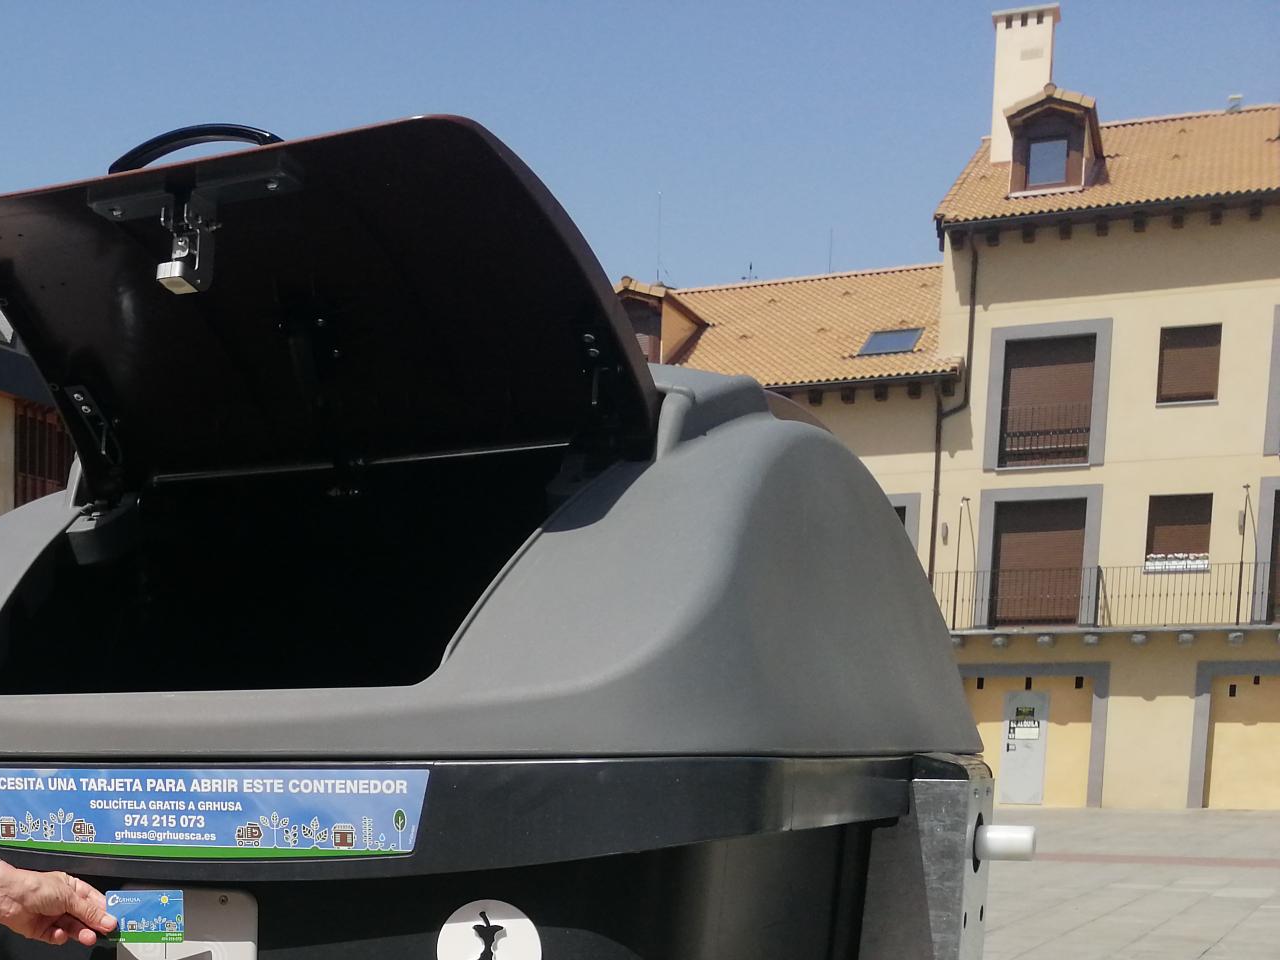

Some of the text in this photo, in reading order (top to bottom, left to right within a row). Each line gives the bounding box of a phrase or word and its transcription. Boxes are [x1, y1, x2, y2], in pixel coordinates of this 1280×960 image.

[48, 778, 76, 791] UNA
[80, 778, 143, 792] TARJETA
[146, 778, 186, 792] PARA
[190, 779, 238, 793] ABRIR
[243, 779, 284, 793] ESTE
[288, 780, 408, 794] CONTENEDOR
[89, 797, 243, 811] SOLICÍTELA GRATIS A GRHUSA
[124, 814, 205, 828] 974 215 073
[114, 830, 216, 841] grhusa@grhuesca.es
